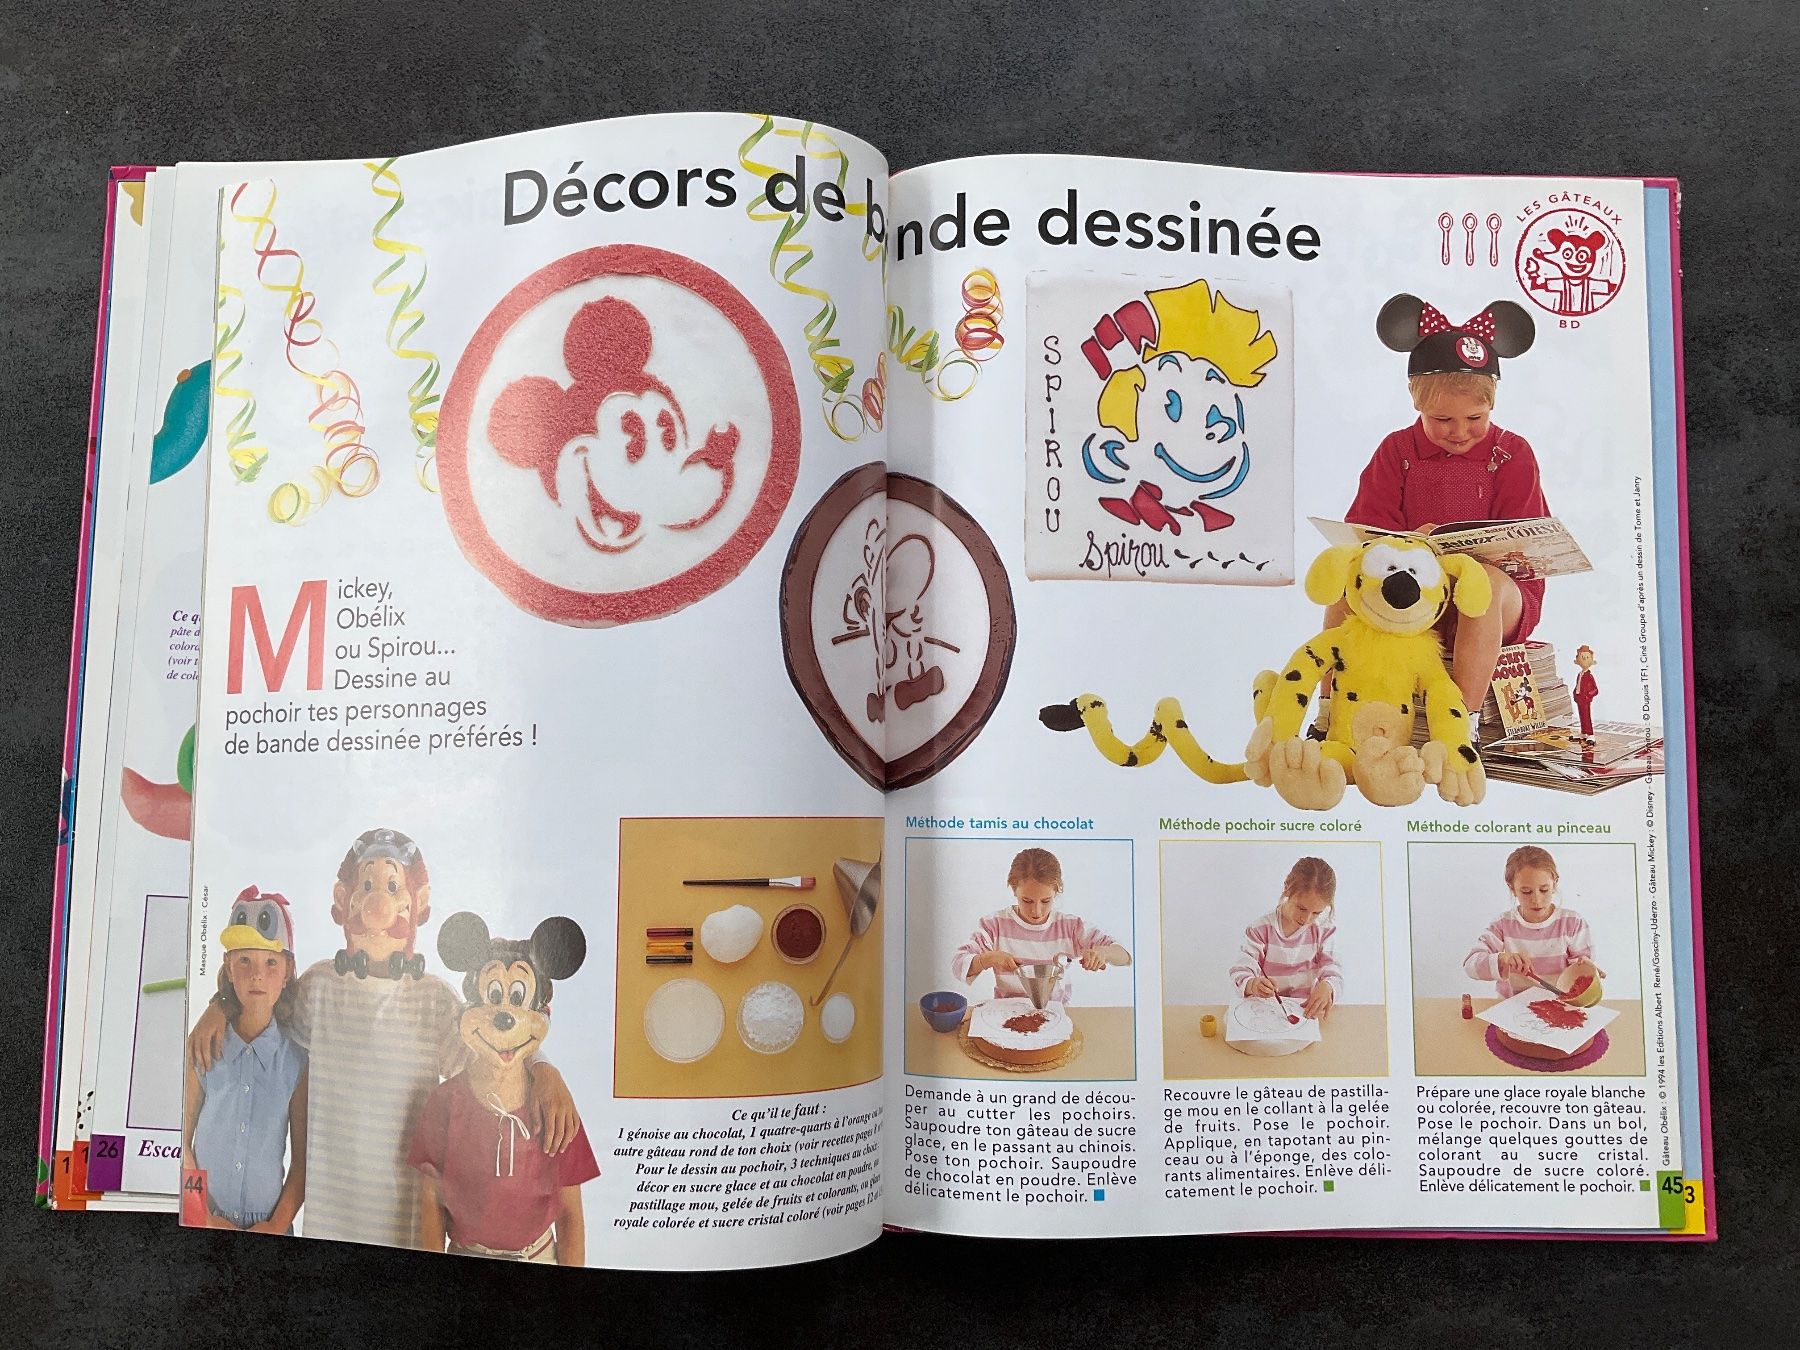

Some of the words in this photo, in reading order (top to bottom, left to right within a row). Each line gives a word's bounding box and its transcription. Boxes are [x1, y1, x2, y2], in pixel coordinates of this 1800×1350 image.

[504, 161, 737, 226] Décors
[765, 155, 845, 222] de
[1038, 189, 1321, 262] dessinée
[1517, 200, 1540, 222] LES
[1549, 191, 1622, 226] GÂTEAUX
[1560, 320, 1580, 329] BD
[1632, 476, 1642, 497] Janry
[1633, 498, 1641, 507] et
[1633, 508, 1642, 531] Tome
[1634, 532, 1642, 543] de
[1079, 531, 1169, 577] Spirou
[1634, 544, 1644, 569] dessin
[1637, 570, 1644, 581] un
[173, 610, 188, 621] Ce
[336, 604, 406, 629] Obélix
[1638, 614, 1648, 643] Groupe
[335, 643, 360, 659] ou
[1639, 645, 1648, 663] Ciné
[167, 670, 178, 679] de
[334, 667, 417, 690] Dessine
[425, 669, 451, 686] au
[1641, 684, 1650, 712] Dupuis
[226, 702, 301, 730] pochoir
[308, 704, 338, 721] tes
[346, 700, 487, 725] personnages
[224, 733, 249, 755] de
[256, 731, 319, 754] bande
[327, 728, 421, 751] dessinée
[1645, 792, 1655, 818] Disney
[906, 816, 964, 829] Méthode
[969, 817, 1008, 829] tamis
[1012, 819, 1029, 829] au
[1034, 817, 1093, 830] chocolat
[1159, 819, 1220, 831] Méthode
[1225, 819, 1277, 834] pochoir
[1280, 822, 1315, 831] sucre
[1320, 820, 1362, 832] coloré
[1407, 820, 1469, 833] Méthode
[1475, 821, 1531, 833] colorant
[1536, 824, 1552, 833] au
[1557, 822, 1611, 836] pinceau
[1646, 834, 1657, 862] Mickey
[1648, 864, 1657, 894] Gâteau
[201, 885, 209, 908] César
[200, 915, 208, 942] Obélix
[199, 944, 207, 976] Masque
[1652, 992, 1663, 1018] Albert
[1654, 1020, 1665, 1053] Editions
[1655, 1055, 1665, 1067] les
[1656, 1069, 1666, 1089] 1994
[905, 1085, 971, 1101] Demande
[977, 1090, 984, 1102] à
[990, 1093, 1007, 1103] un
[1013, 1091, 1056, 1107] grand
[1062, 1091, 1079, 1104] de
[1085, 1091, 1136, 1104] décou-
[1164, 1089, 1230, 1101] Recouvre
[1237, 1087, 1248, 1099] le
[1254, 1087, 1302, 1102] gâteau
[1308, 1085, 1325, 1097] de
[1331, 1084, 1388, 1100] pastilla-
[1417, 1085, 1470, 1102] Prépare
[1475, 1088, 1499, 1098] une
[1504, 1085, 1540, 1102] glace
[1546, 1086, 1586, 1101] royale
[1591, 1086, 1645, 1098] blanche
[732, 1109, 748, 1121] Ce
[780, 1108, 790, 1118] te
[792, 1104, 819, 1120] faut
[905, 1104, 927, 1117] per
[939, 1108, 955, 1117] au
[968, 1109, 1015, 1120] cutter
[1029, 1108, 1050, 1120] les
[1063, 1108, 1136, 1123] pochoirs.
[1164, 1107, 1181, 1120] ge
[1188, 1107, 1218, 1116] mou
[1224, 1106, 1240, 1116] en
[1247, 1103, 1258, 1115] le
[1264, 1102, 1313, 1114] collant
[1319, 1101, 1325, 1113] à
[1331, 1100, 1342, 1113] la
[1349, 1100, 1389, 1116] gelée
[1417, 1104, 1434, 1113] ou
[1439, 1101, 1495, 1115] colorée,
[1500, 1104, 1560, 1113] recouvre
[1566, 1103, 1588, 1113] ton
[1594, 1101, 1645, 1116] gâteau.
[905, 1117, 980, 1135] Saupoudre
[986, 1125, 1010, 1136] ton
[1017, 1124, 1068, 1139] gâteau
[1074, 1124, 1092, 1136] de
[1098, 1127, 1136, 1136] sucre
[1659, 1106, 1669, 1134] Obélix
[96, 1141, 118, 1158] 26
[614, 1147, 642, 1157] autre
[648, 1145, 685, 1159] gâteau
[690, 1145, 715, 1157] rond
[721, 1145, 734, 1156] de
[738, 1147, 756, 1156] ton
[760, 1144, 790, 1155] choix
[795, 1140, 819, 1153] (voir
[821, 1135, 853, 1149] recettes
[1661, 1136, 1670, 1166] Gâteau
[635, 1163, 663, 1175] Pour
[667, 1163, 677, 1174] le
[681, 1163, 717, 1174] dessin
[721, 1165, 736, 1174] au
[739, 1160, 787, 1176] pochoir,
[790, 1158, 797, 1169] 3
[800, 1151, 850, 1168] techniques
[185, 1175, 204, 1194] 44
[905, 1183, 1001, 1202] délicatement
[1007, 1188, 1019, 1202] le
[1026, 1189, 1087, 1205] pochoir.
[1420, 1179, 1464, 1192] Enlève
[1469, 1179, 1559, 1192] délicatement
[1563, 1180, 1575, 1192] le
[1580, 1180, 1635, 1194] pochoir.
[1662, 1177, 1683, 1194] 45
